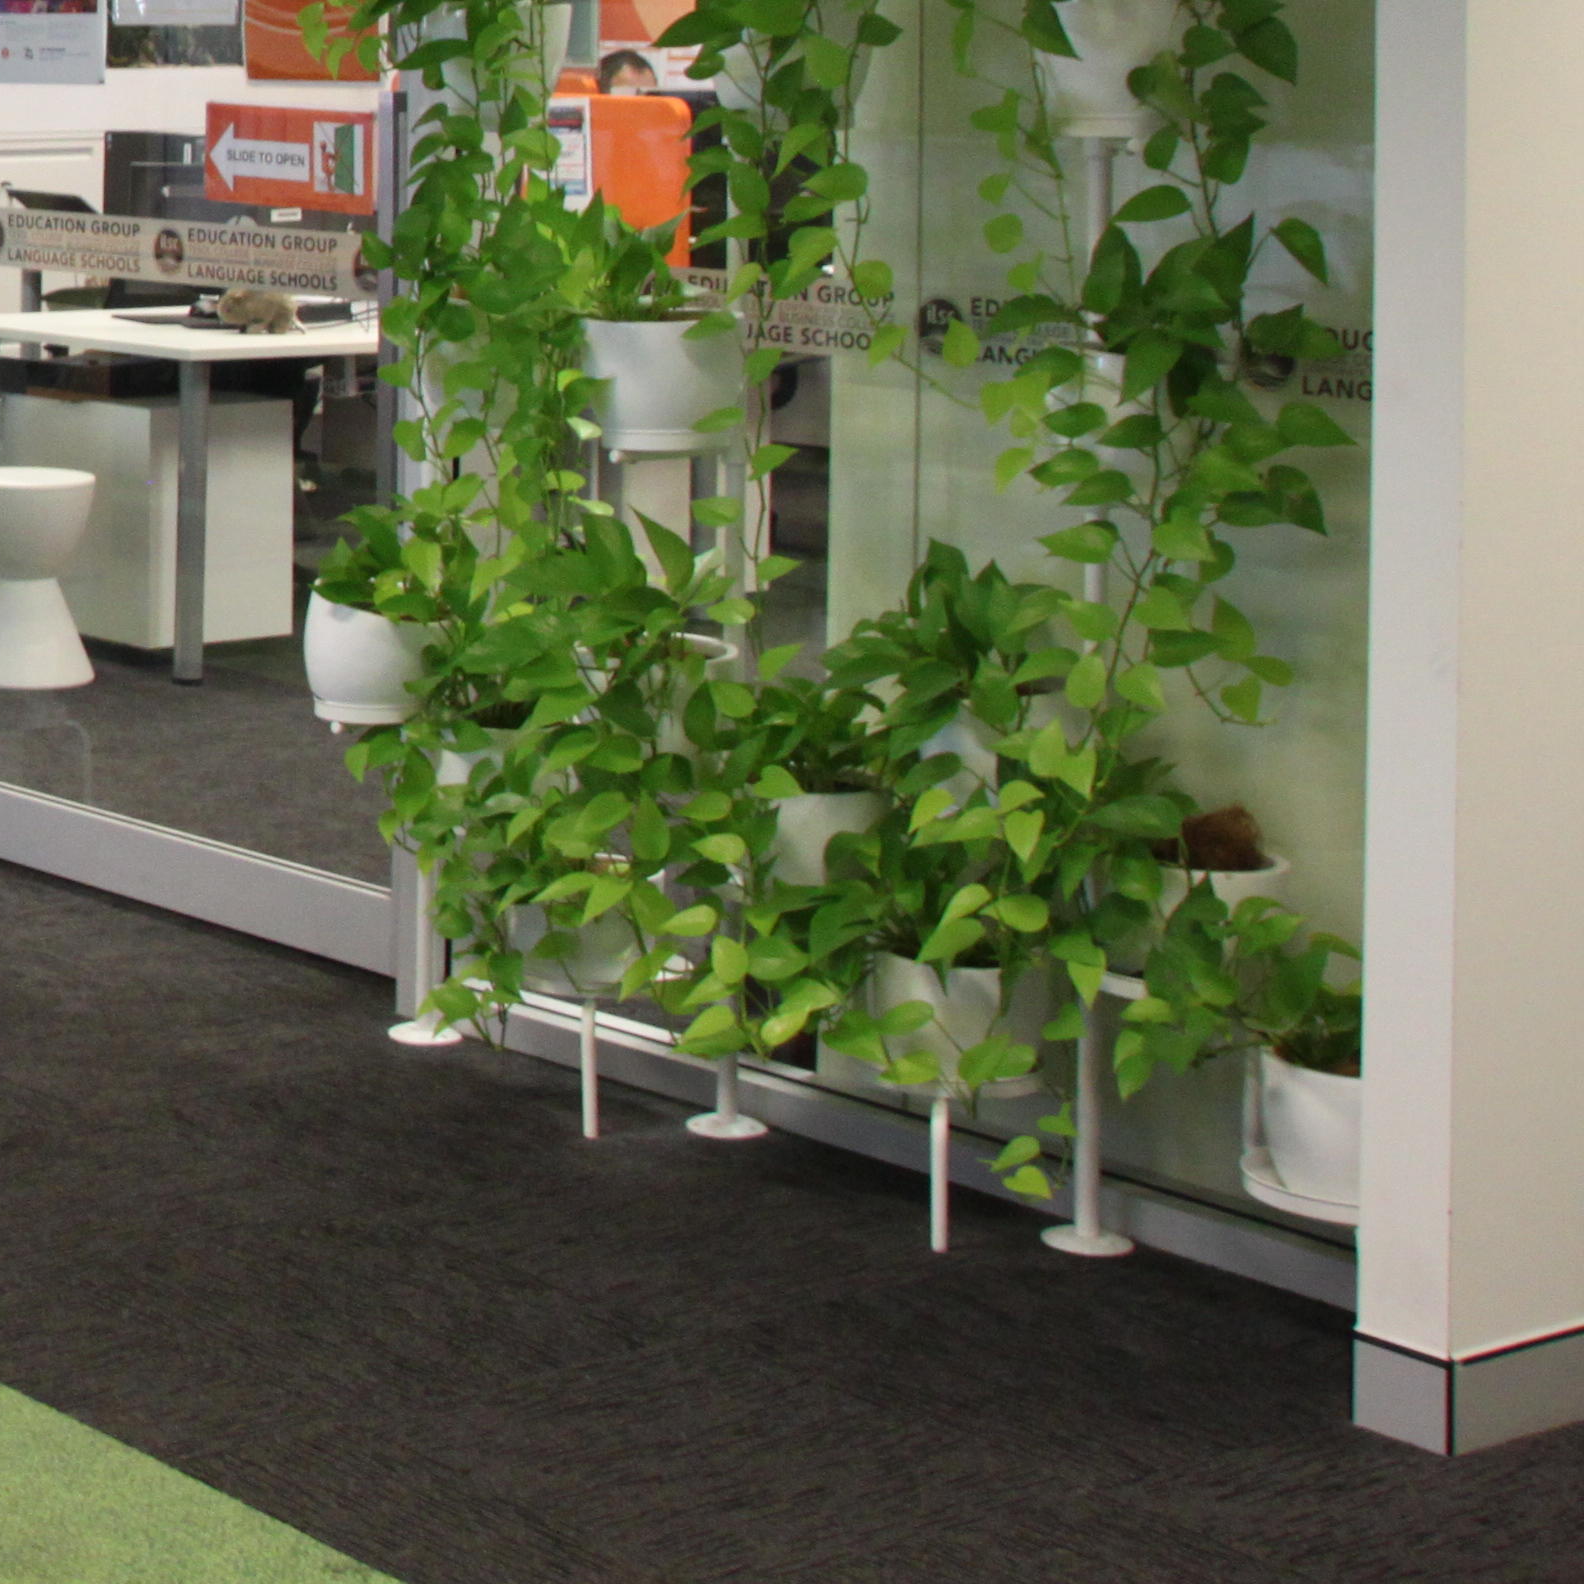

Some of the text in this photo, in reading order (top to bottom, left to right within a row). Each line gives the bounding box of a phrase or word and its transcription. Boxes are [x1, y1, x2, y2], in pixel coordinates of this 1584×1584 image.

[227, 150, 305, 166] SLIDE TO OPEN
[8, 213, 141, 237] EDUCATION GROUP
[188, 227, 338, 253] EDUCATION GROUP
[8, 248, 141, 273] LANGUAGE SCHOOLS
[188, 263, 338, 291] LANGUAGE SCHOOLS
